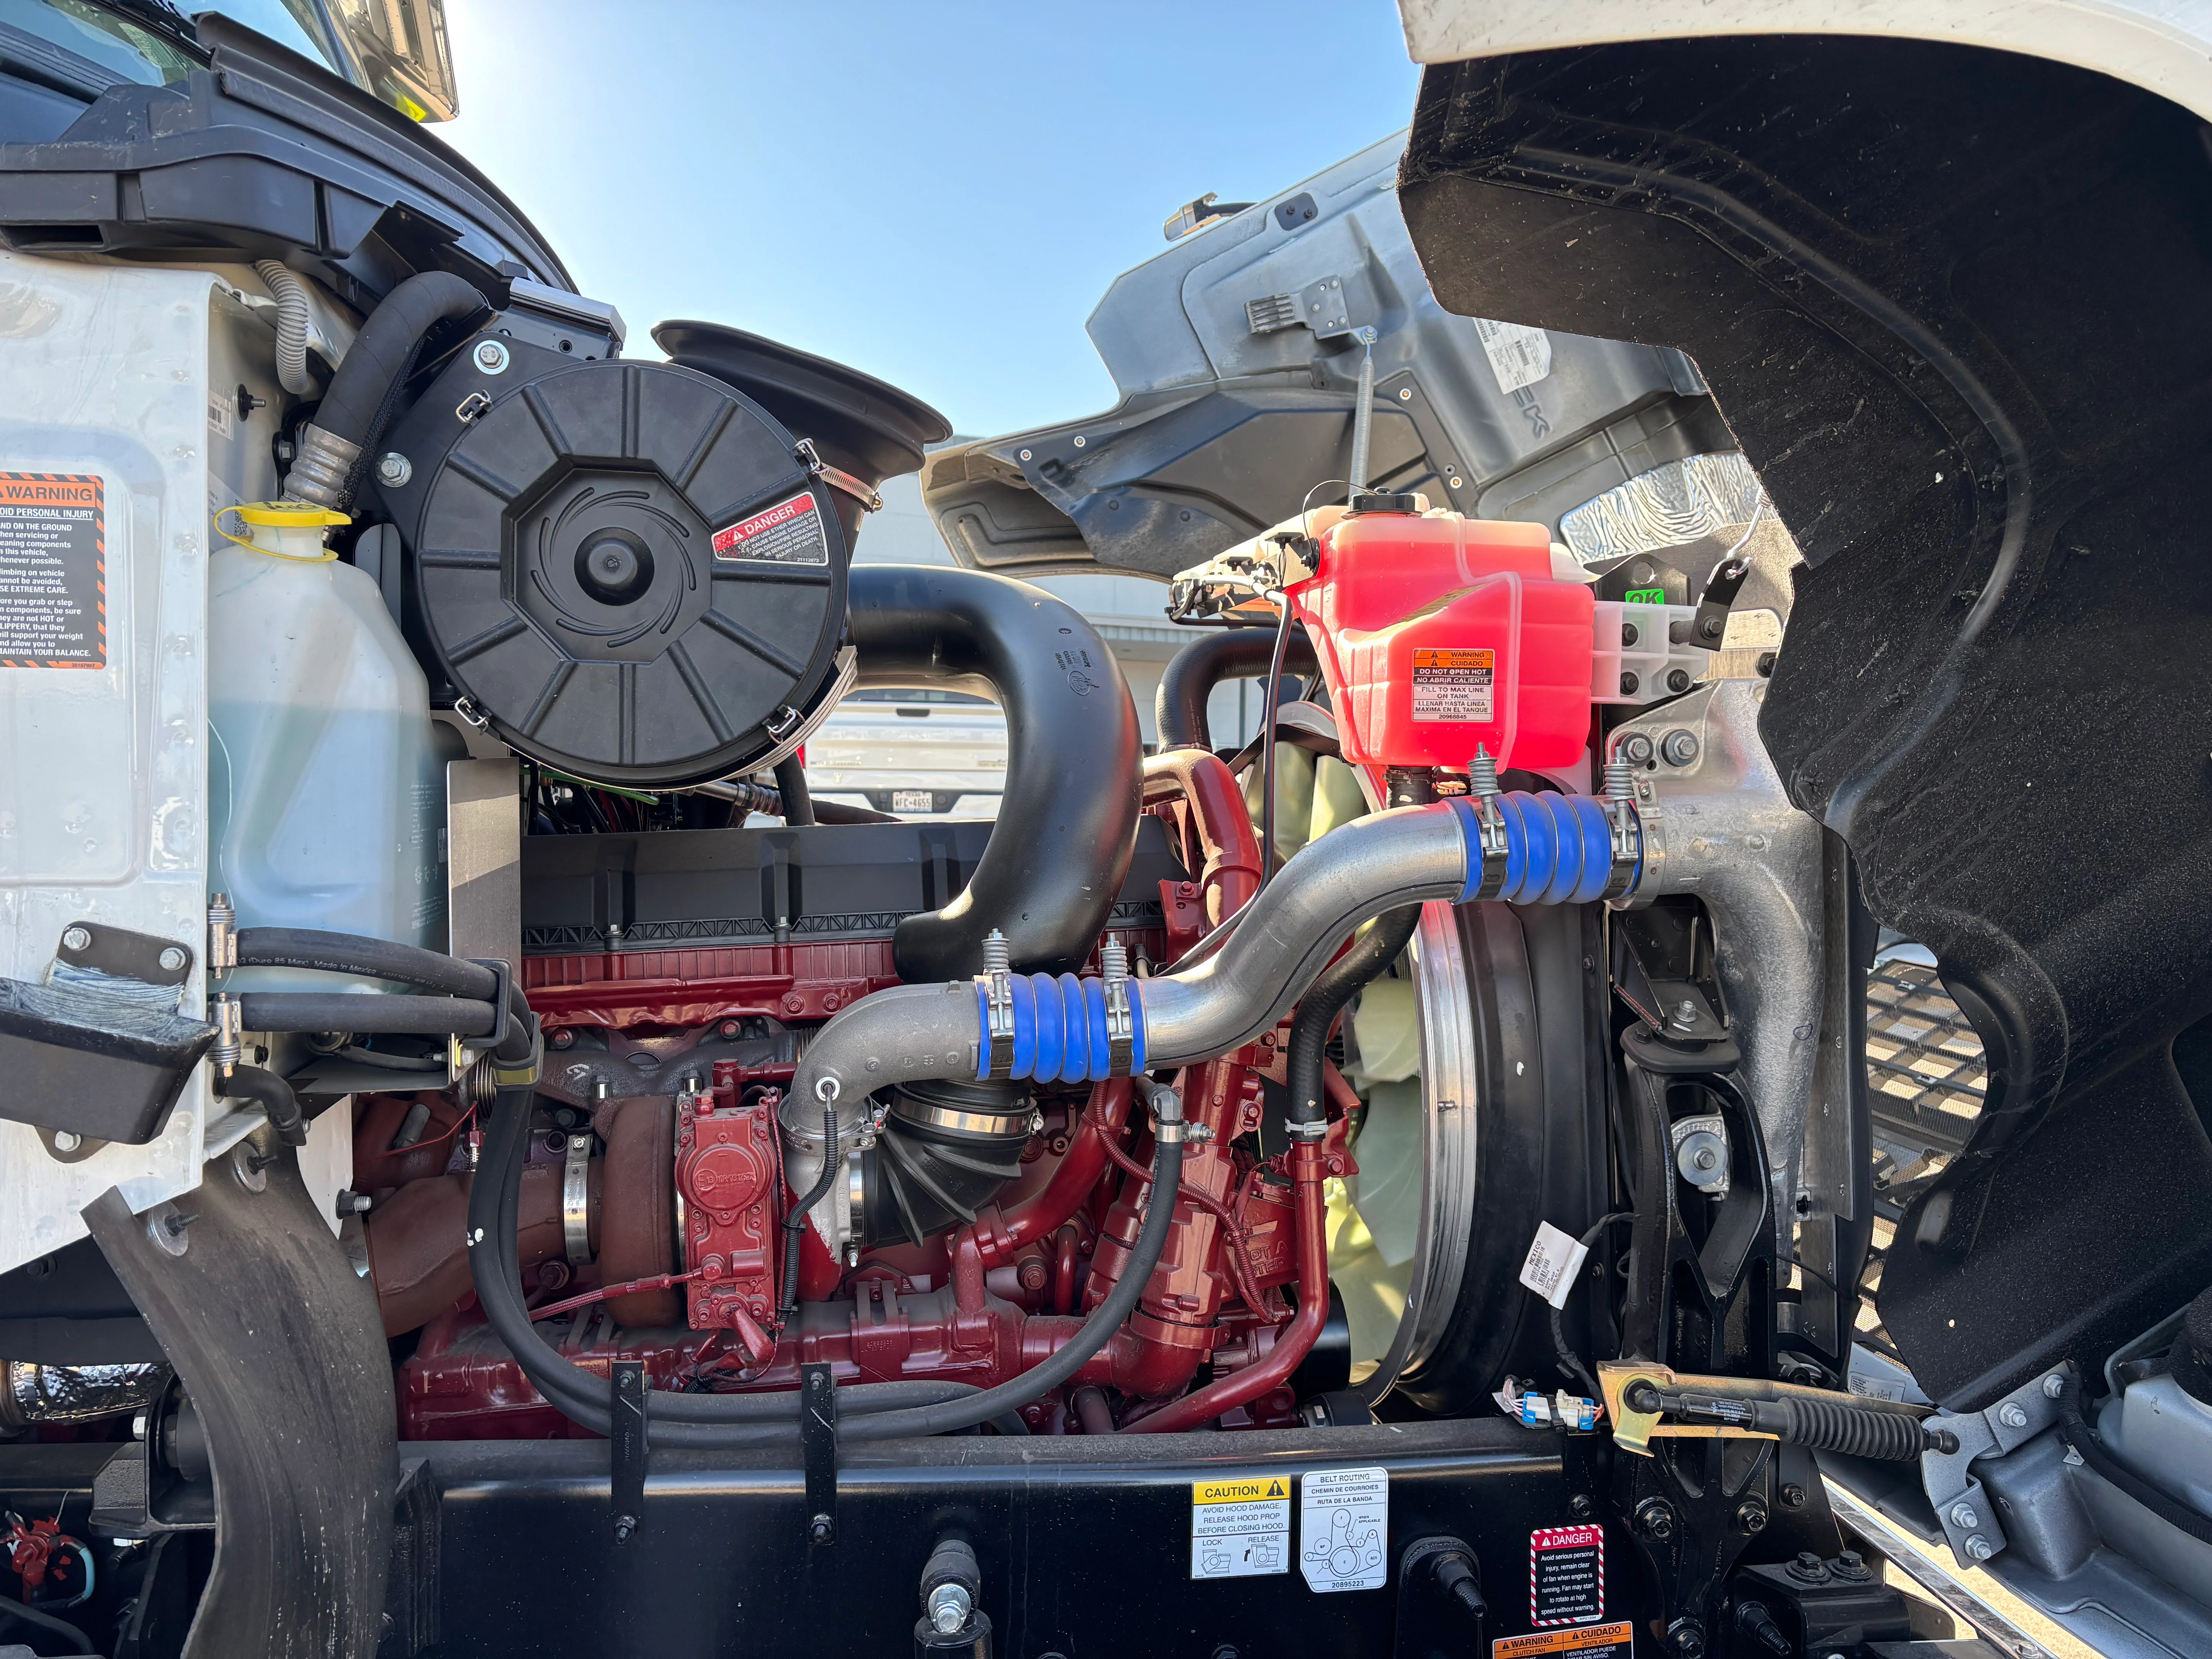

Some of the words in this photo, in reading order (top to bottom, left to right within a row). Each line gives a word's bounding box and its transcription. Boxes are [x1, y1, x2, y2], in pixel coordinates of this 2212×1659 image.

[6, 486, 92, 501] WARNING
[16, 508, 60, 517] PERSONAL
[63, 510, 93, 518] INJURY
[744, 505, 795, 535] DANGER
[771, 522, 788, 534] ETHER
[788, 516, 804, 526] WHICH
[751, 539, 769, 549] CAUSE
[769, 531, 787, 542] ENGINE
[787, 521, 808, 532] DAMAGE
[752, 536, 791, 556] EXPLOSION/FIRE
[791, 524, 818, 538] RESULTING
[771, 542, 792, 553] SERIOUS
[792, 530, 818, 544] PERSONAL
[776, 548, 793, 558] INJURY
[1629, 591, 1661, 604] OK
[314, 960, 337, 969] Made
[349, 965, 376, 974] Mexico
[1250, 1245, 1271, 1261] OT
[1529, 1241, 1541, 1266] MEXICO
[1253, 1257, 1284, 1275] TEP
[1205, 1486, 1259, 1498] CAUTION
[1228, 1524, 1260, 1532] CLOSING
[1553, 1532, 1592, 1546] DANGER
[1574, 1551, 1594, 1559] personal
[1511, 1636, 1553, 1648] WARNING
[1581, 1626, 1621, 1638] CUIDADO
[1581, 1638, 1613, 1646] VENTILADOR
[1566, 1648, 1598, 1657] VENTILADOR
